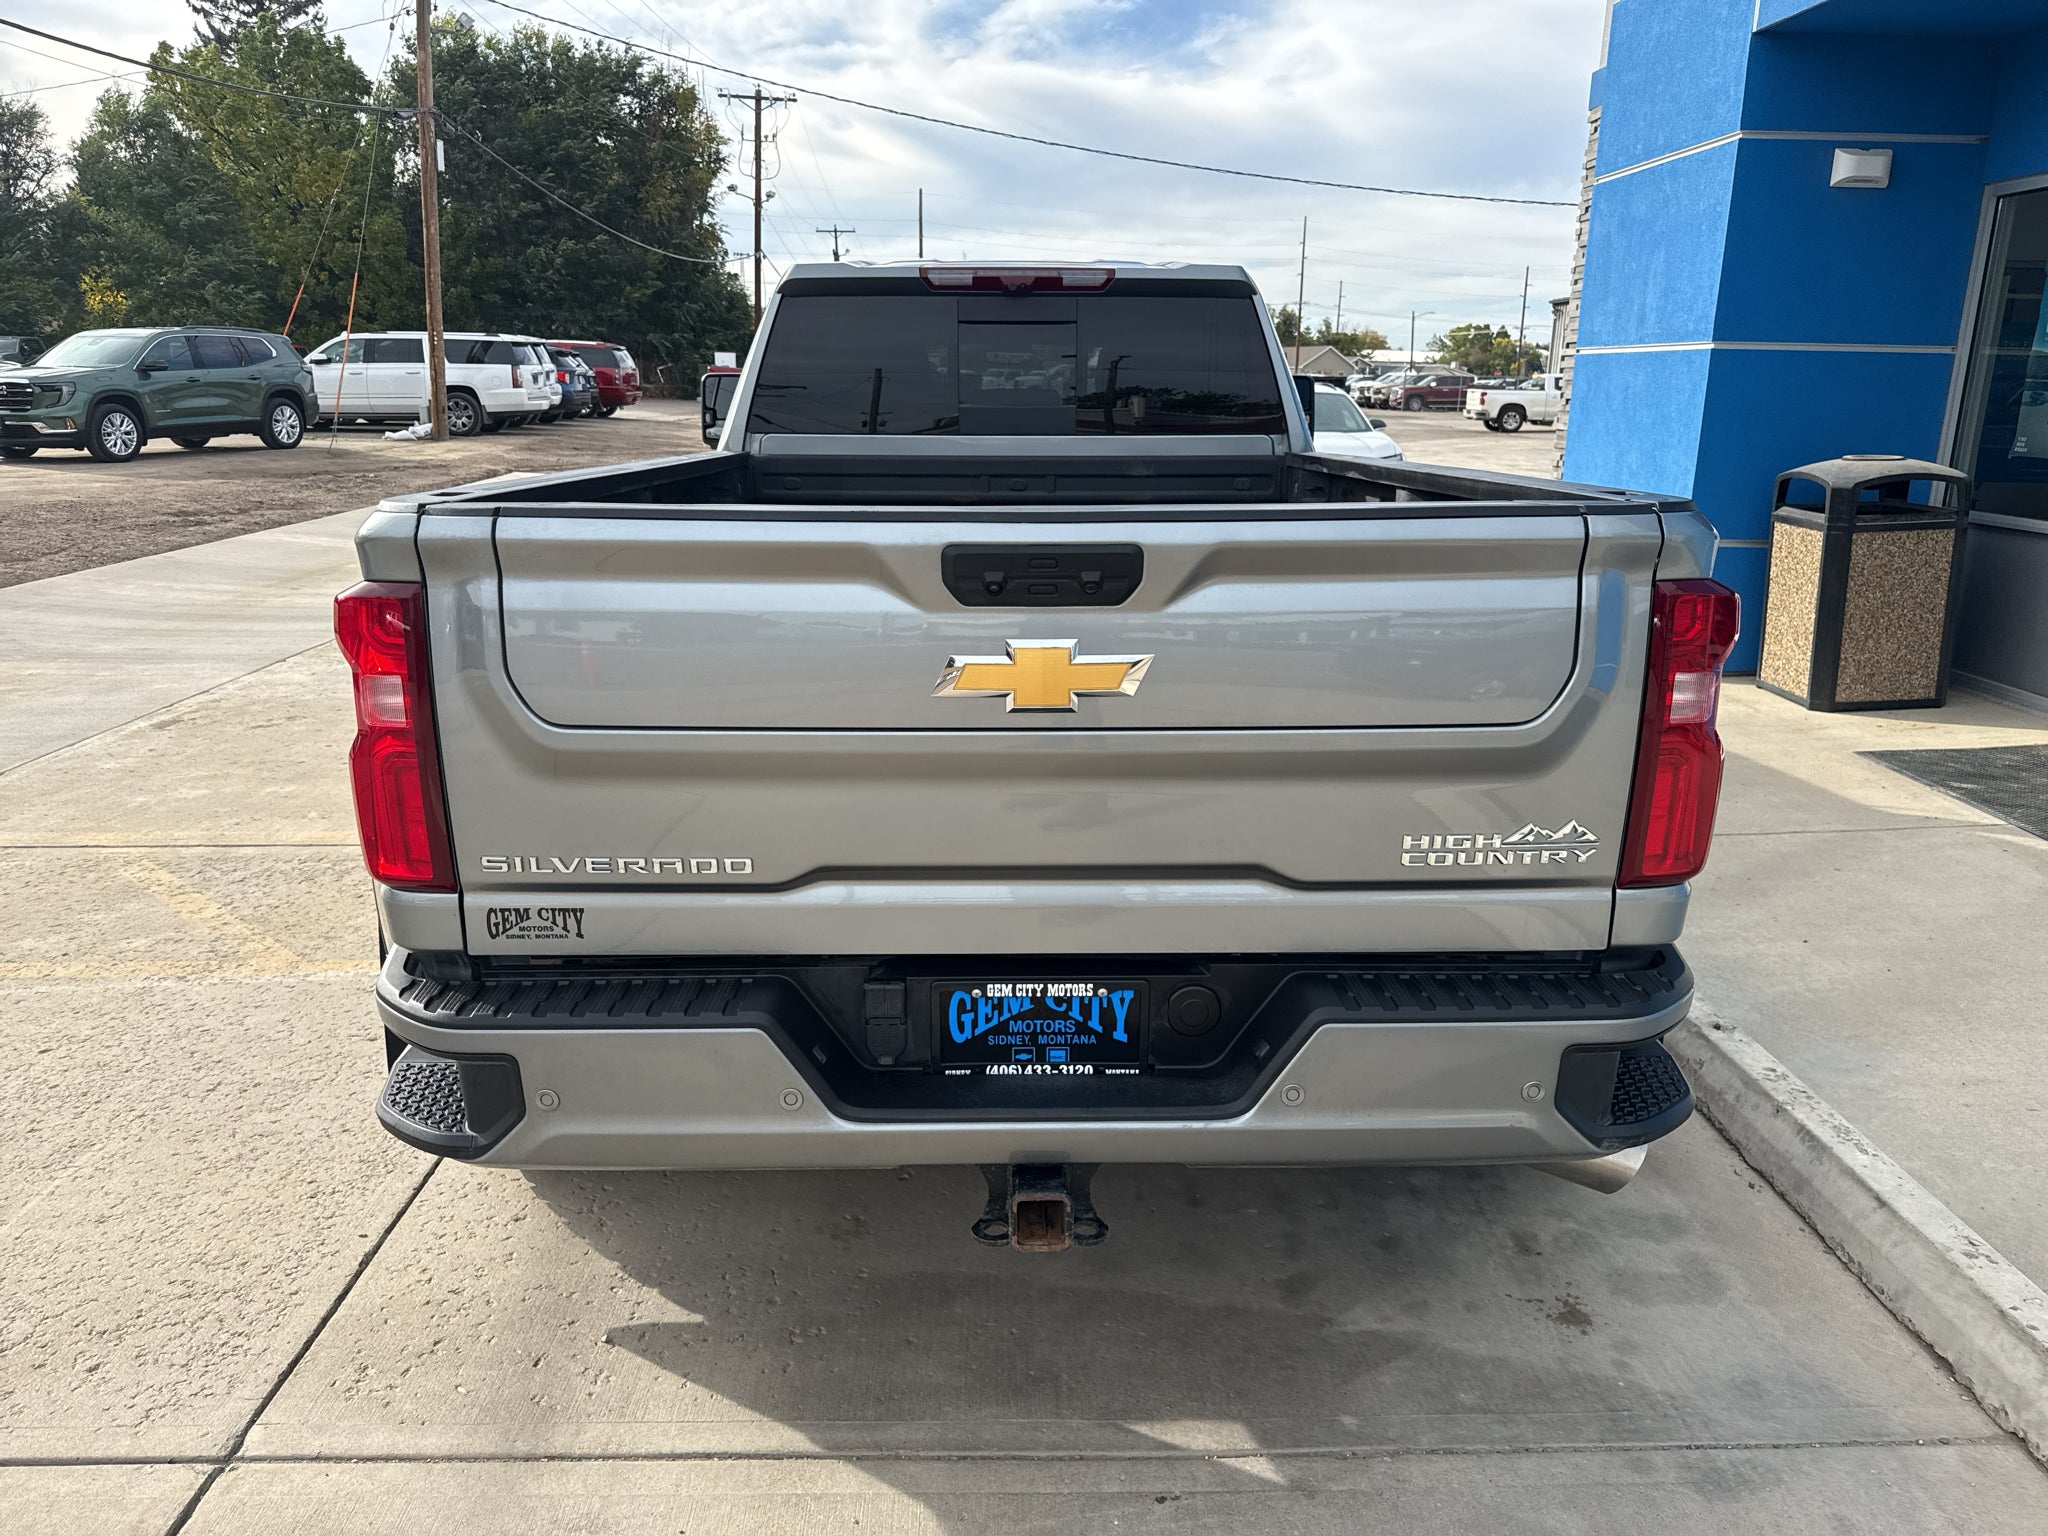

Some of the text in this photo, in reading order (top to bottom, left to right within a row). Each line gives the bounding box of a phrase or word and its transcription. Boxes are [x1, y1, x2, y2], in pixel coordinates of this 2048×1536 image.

[1402, 834, 1502, 850] HIGH
[480, 856, 754, 875] SILVERADO
[1401, 849, 1597, 866] COUNTRY
[486, 907, 585, 940] GEM CITY
[518, 925, 555, 933] MOTORS
[986, 983, 1094, 997] GEM CITY MOTORS
[949, 989, 1135, 1044] GEM CITY
[1009, 1019, 1076, 1033] MOTORS
[987, 1034, 1097, 1046] SIDNEY, MONTANA
